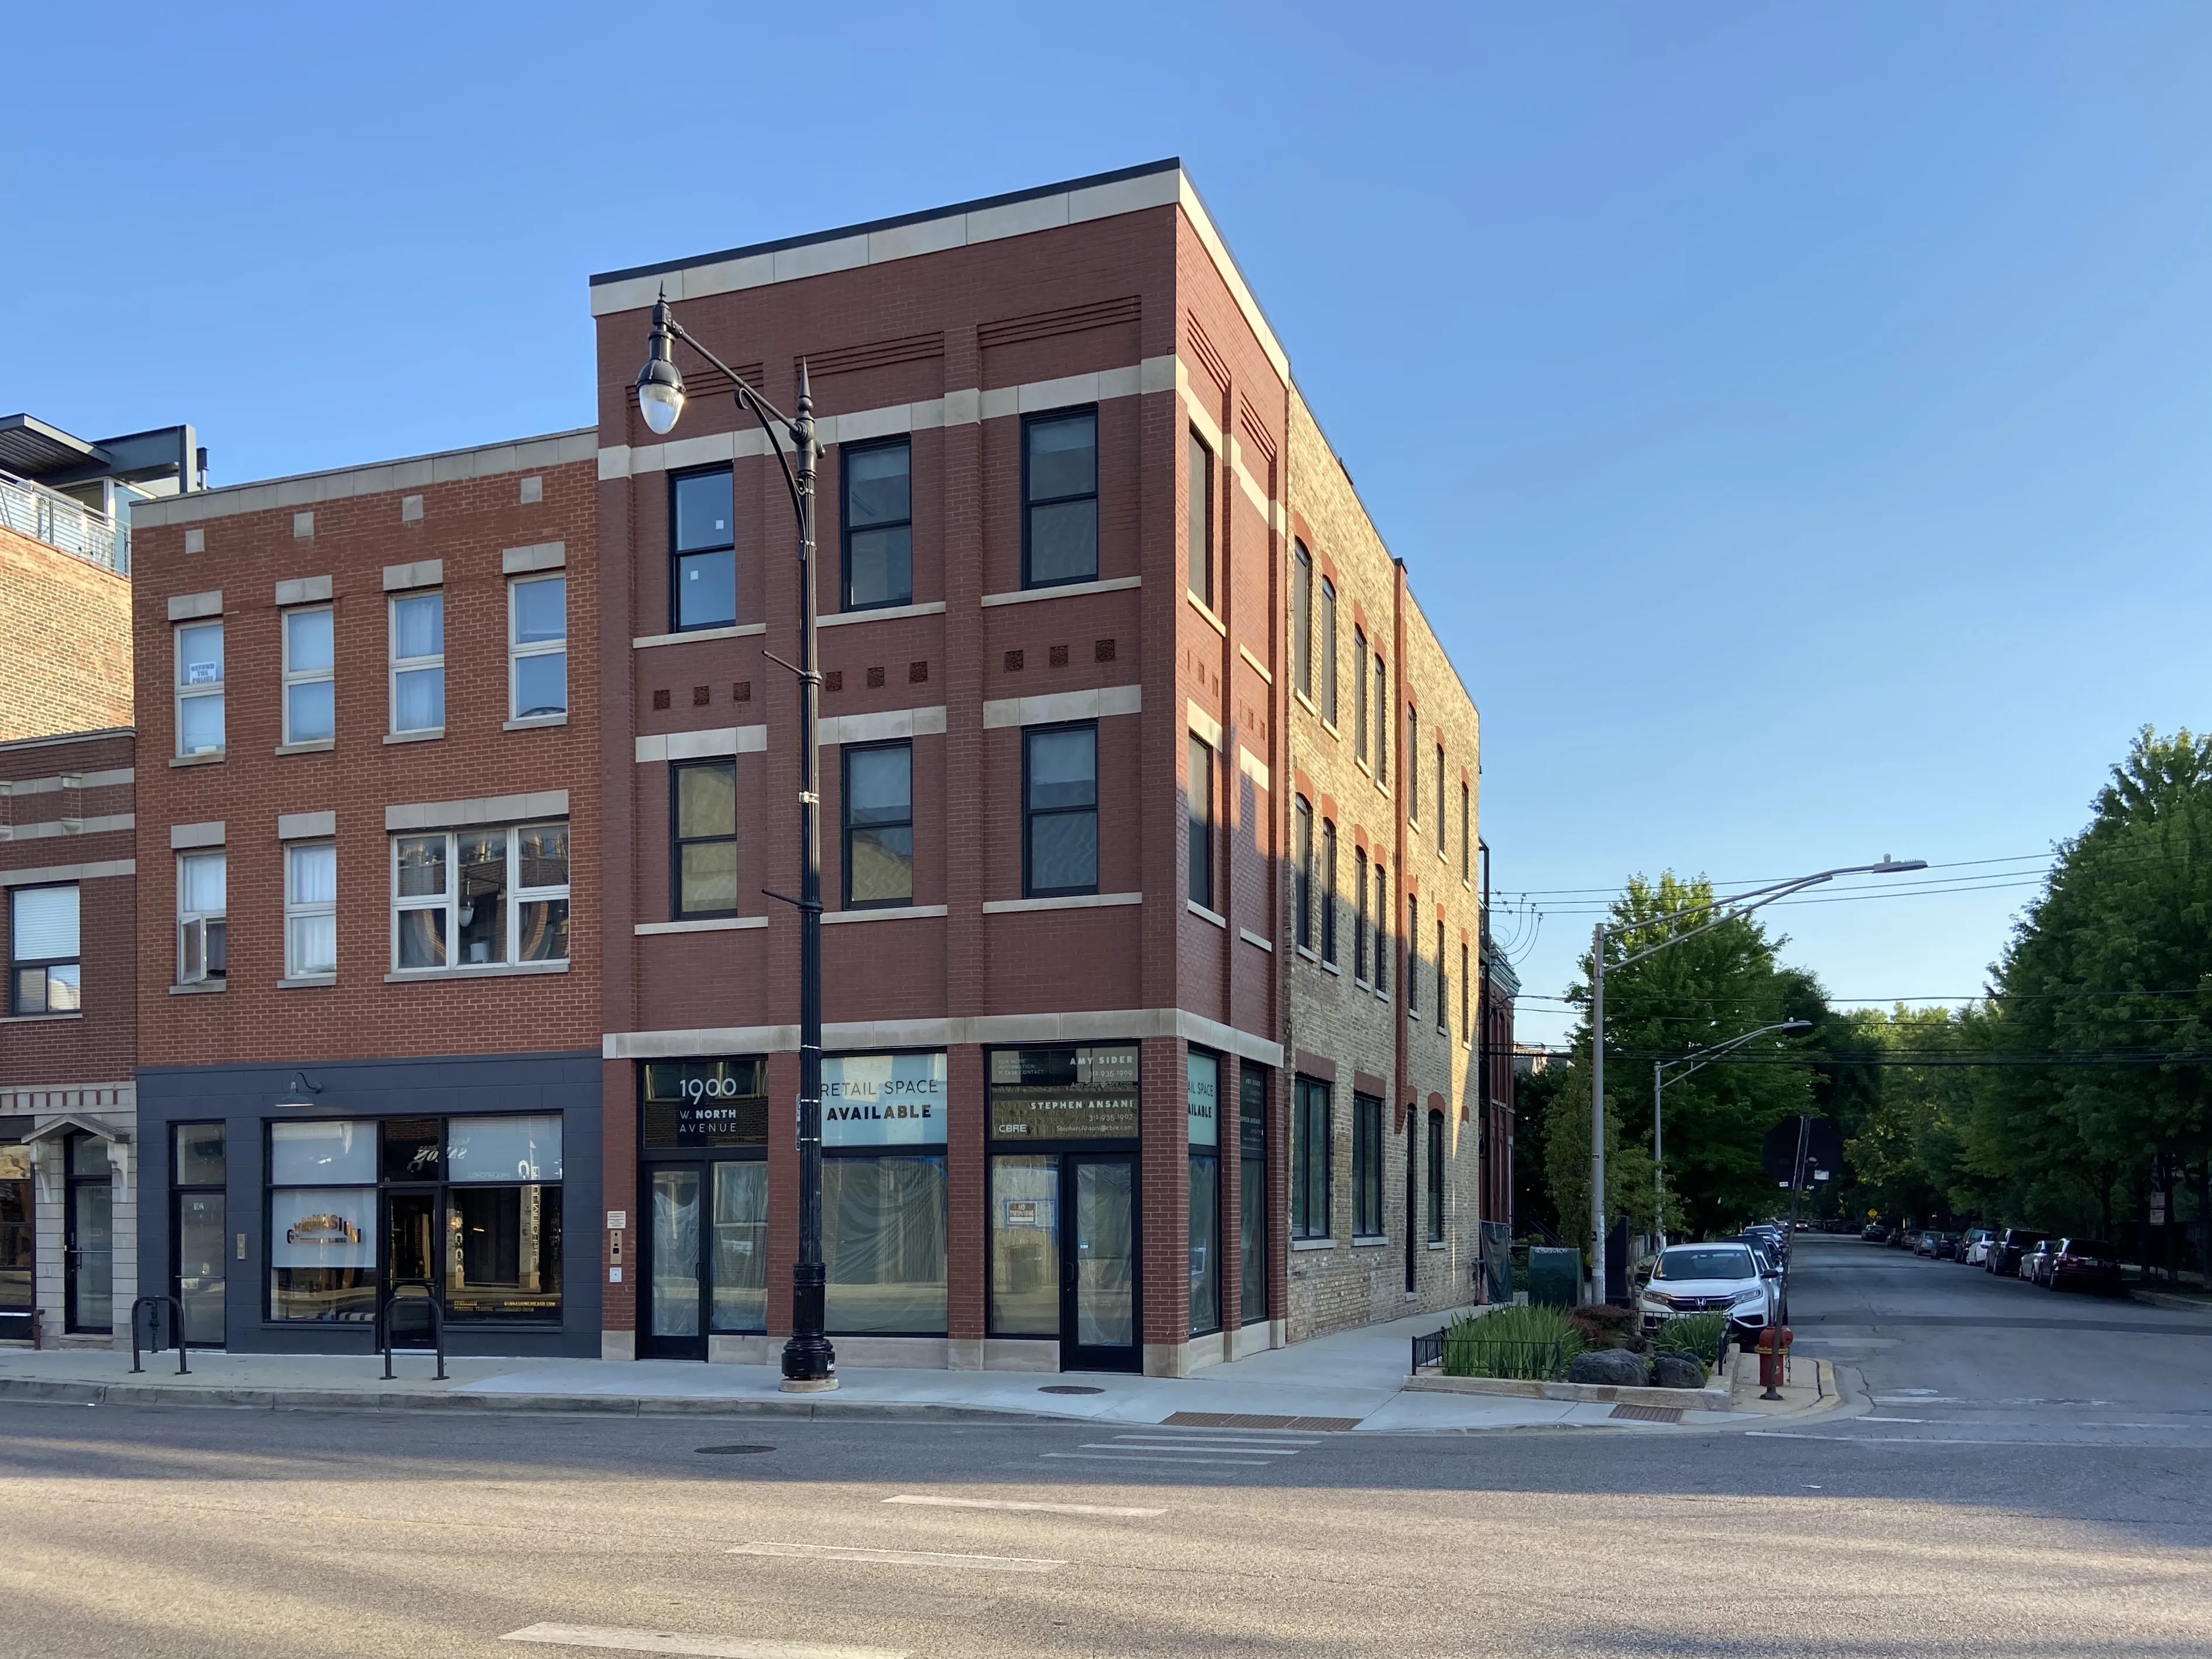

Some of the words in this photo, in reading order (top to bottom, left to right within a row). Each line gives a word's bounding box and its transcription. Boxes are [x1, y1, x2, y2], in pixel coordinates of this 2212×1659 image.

[191, 663, 215, 671] DEFUND
[1070, 1056, 1094, 1066] AMY
[1098, 1056, 1133, 1064] SIDER
[679, 1077, 737, 1105] 1900
[820, 1082, 877, 1097] RETAIL
[884, 1080, 939, 1095] SPACE
[1197, 1082, 1214, 1097] SPACE
[1031, 1101, 1083, 1110] STEPHEN
[1088, 1100, 1133, 1108] ANSANI
[679, 1110, 692, 1119] W.
[696, 1109, 736, 1119] NORTH
[826, 1104, 932, 1121] AVAILABLE
[679, 1122, 737, 1132] AVENUE
[998, 1125, 1027, 1133] CBRE
[287, 1214, 361, 1244] GYMNASIUM
